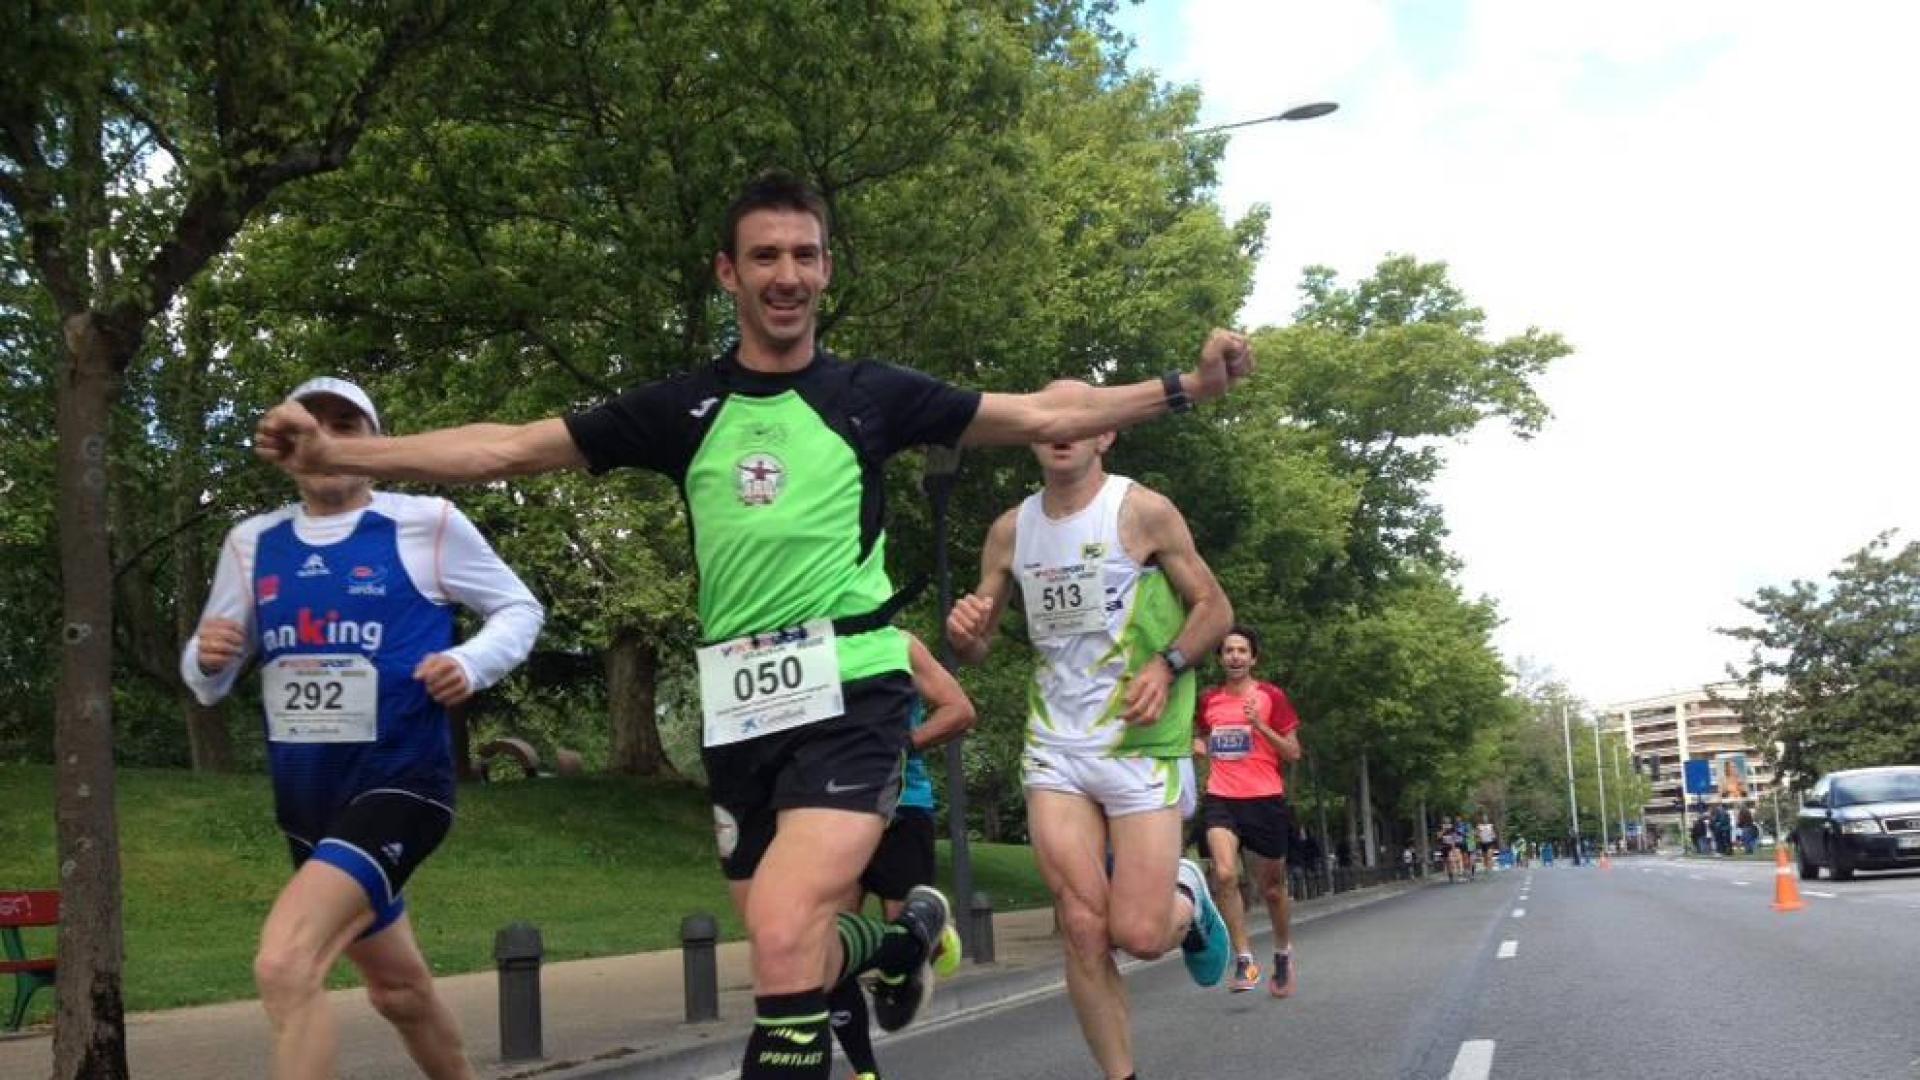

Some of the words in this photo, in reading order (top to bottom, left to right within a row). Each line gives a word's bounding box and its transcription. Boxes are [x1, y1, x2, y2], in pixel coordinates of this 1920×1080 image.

[1043, 583, 1083, 611] 513
[734, 655, 803, 701] 050
[284, 681, 344, 710] 292
